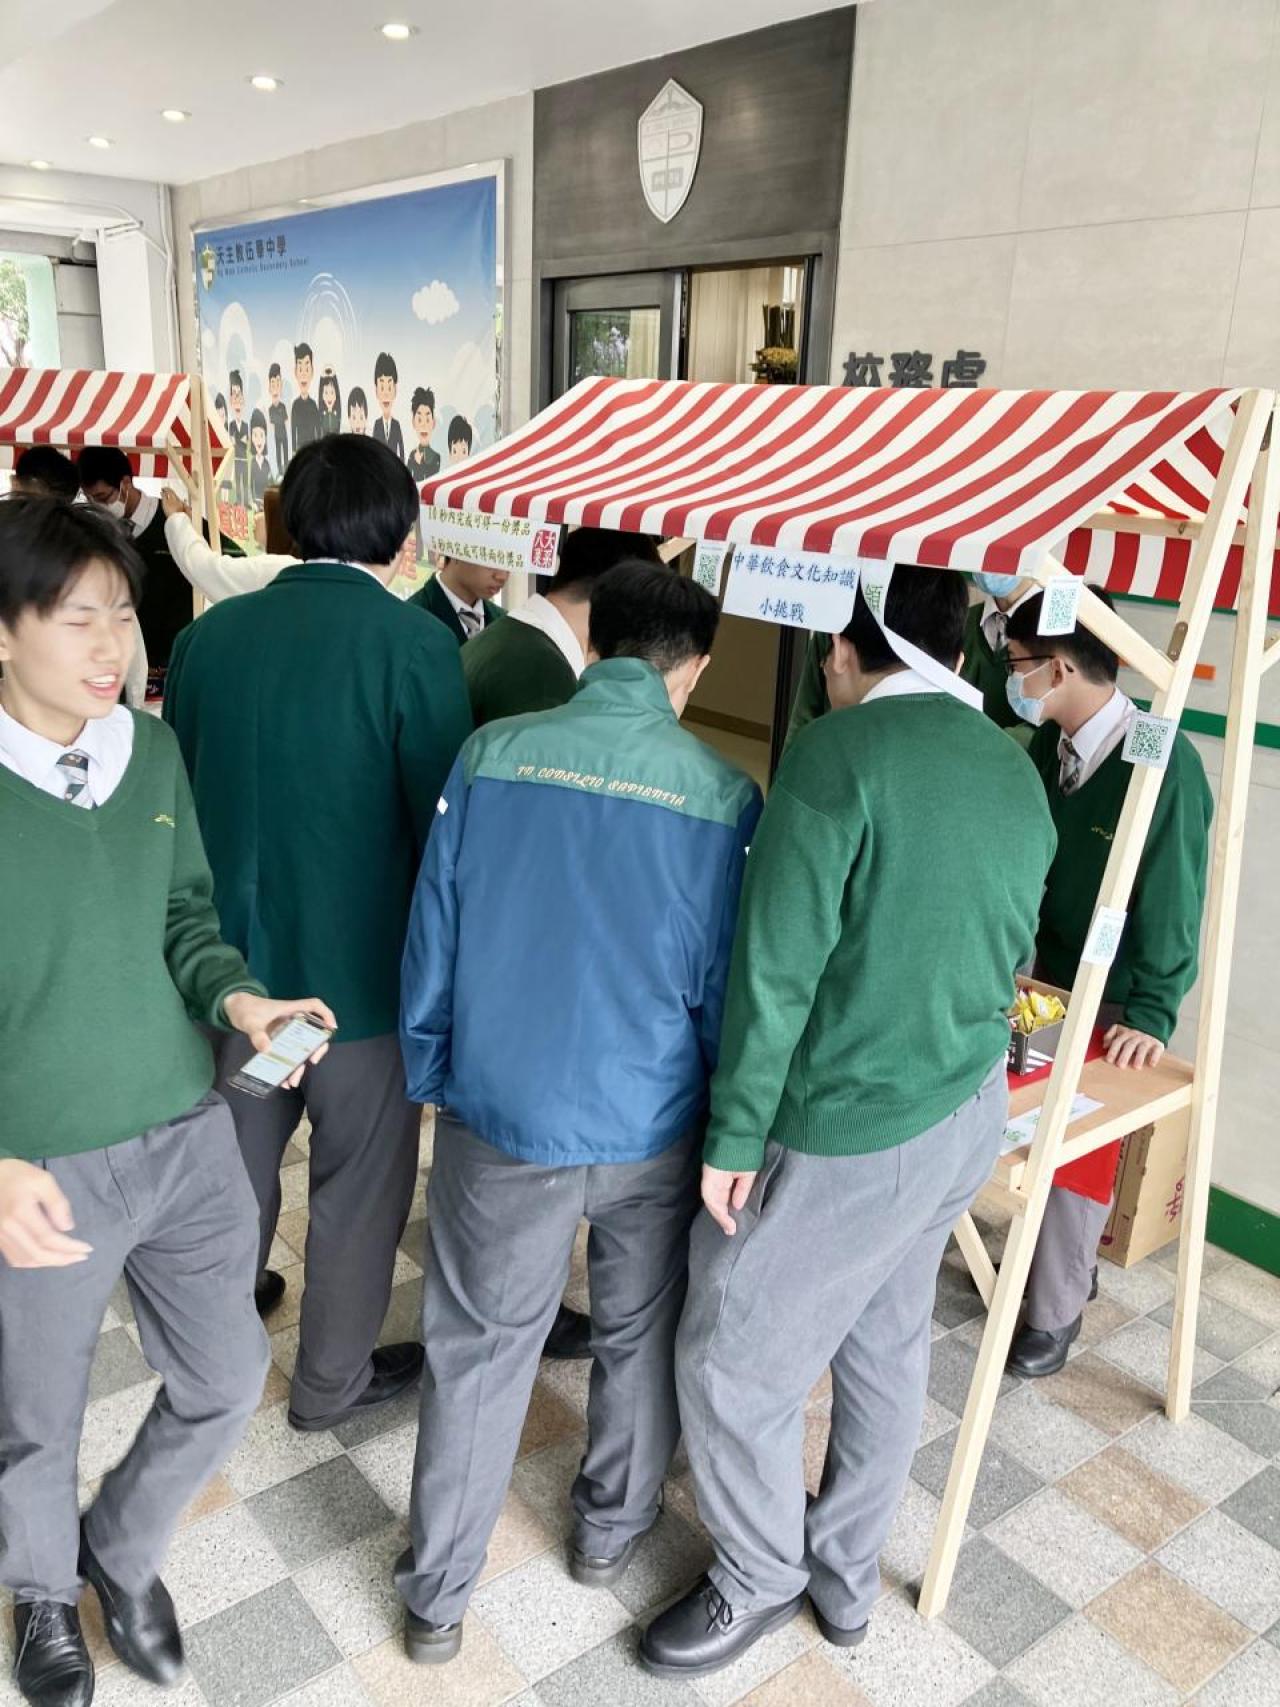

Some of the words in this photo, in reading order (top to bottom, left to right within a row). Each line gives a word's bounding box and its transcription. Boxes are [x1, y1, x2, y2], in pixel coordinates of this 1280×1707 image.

[843, 350, 986, 388] 校務處
[734, 551, 857, 589] 中華飲食文化知識
[759, 597, 804, 624] 小挑戰
